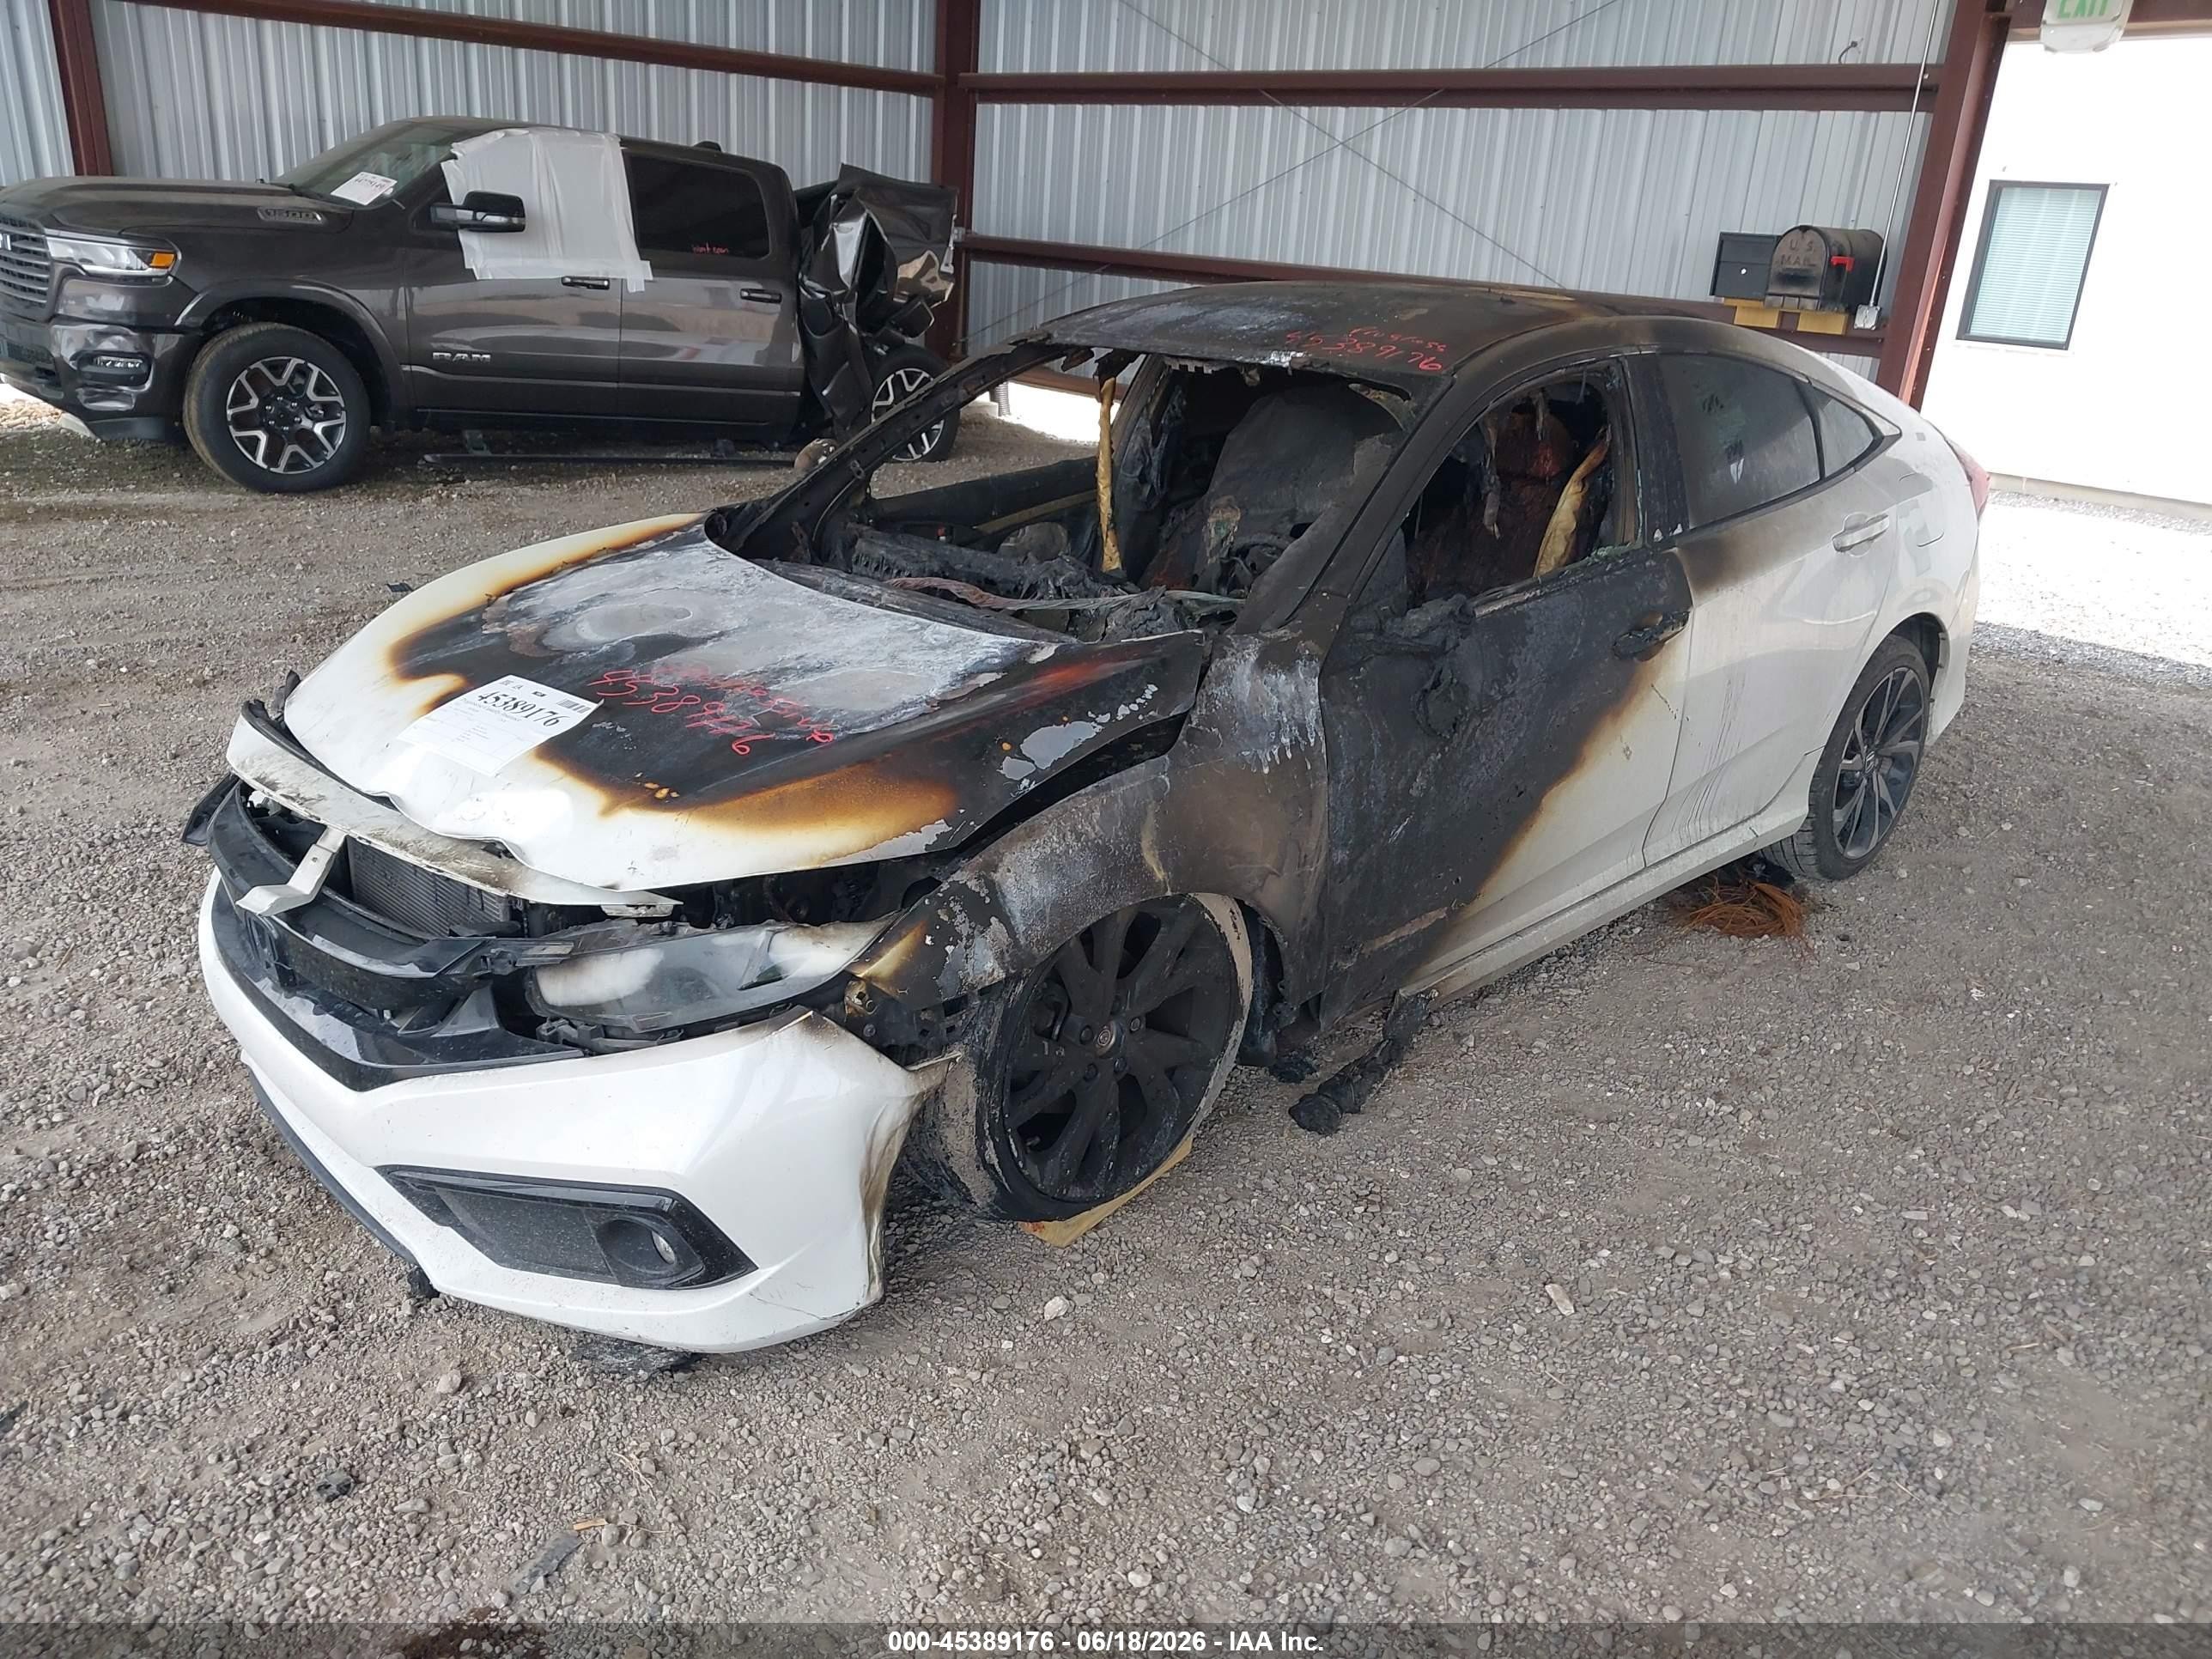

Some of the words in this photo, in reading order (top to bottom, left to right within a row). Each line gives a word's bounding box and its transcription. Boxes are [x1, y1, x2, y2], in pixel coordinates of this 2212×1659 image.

[1781, 254, 1816, 266] MAIL
[432, 351, 491, 362] RAM
[477, 690, 570, 726] 45389176
